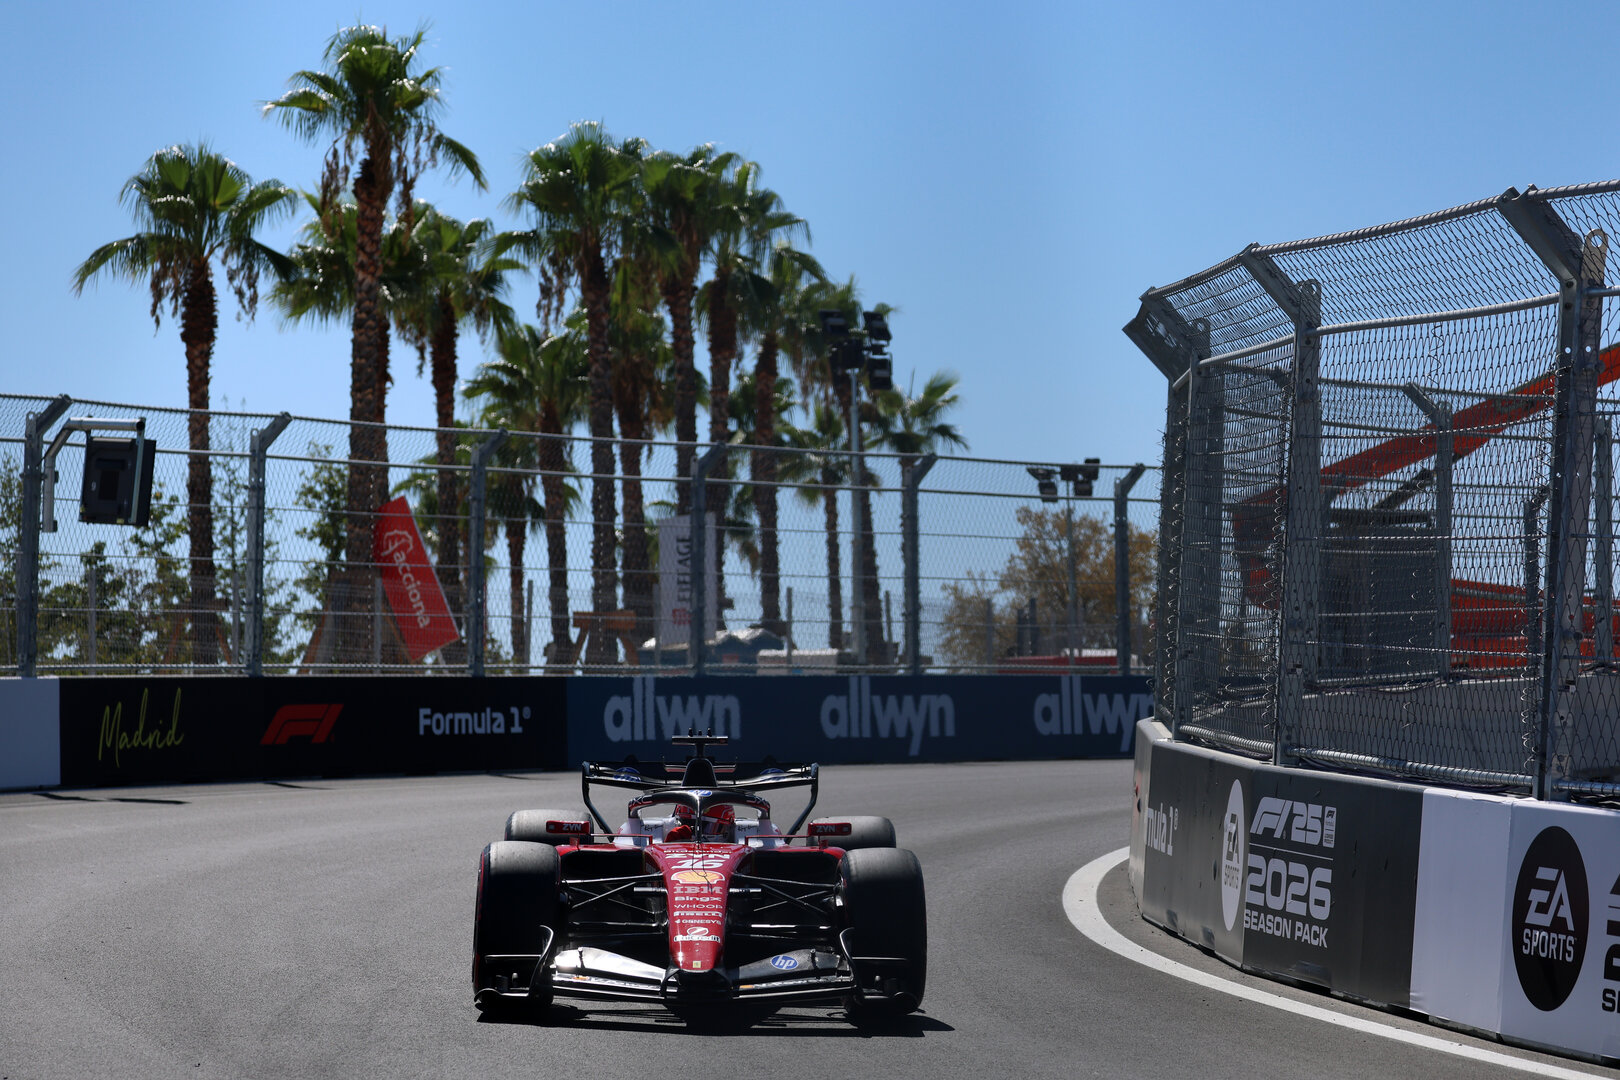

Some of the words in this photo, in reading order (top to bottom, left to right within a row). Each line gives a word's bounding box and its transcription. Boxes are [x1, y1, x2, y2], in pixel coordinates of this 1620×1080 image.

[393, 550, 431, 628] acciona
[98, 688, 184, 768] Madrid
[259, 703, 344, 745] F1
[418, 707, 505, 735] Formula
[820, 675, 956, 757] allwyn
[562, 823, 582, 832] ZYN
[815, 824, 836, 833] ZYN
[671, 859, 726, 869] 16
[673, 886, 723, 894] IBM
[1245, 853, 1333, 921] 2026
[1524, 866, 1575, 932] EA
[1243, 908, 1292, 940] SEASON
[1294, 920, 1329, 948] PACK
[1522, 928, 1576, 963] SPORTS
[774, 955, 795, 970] hp
